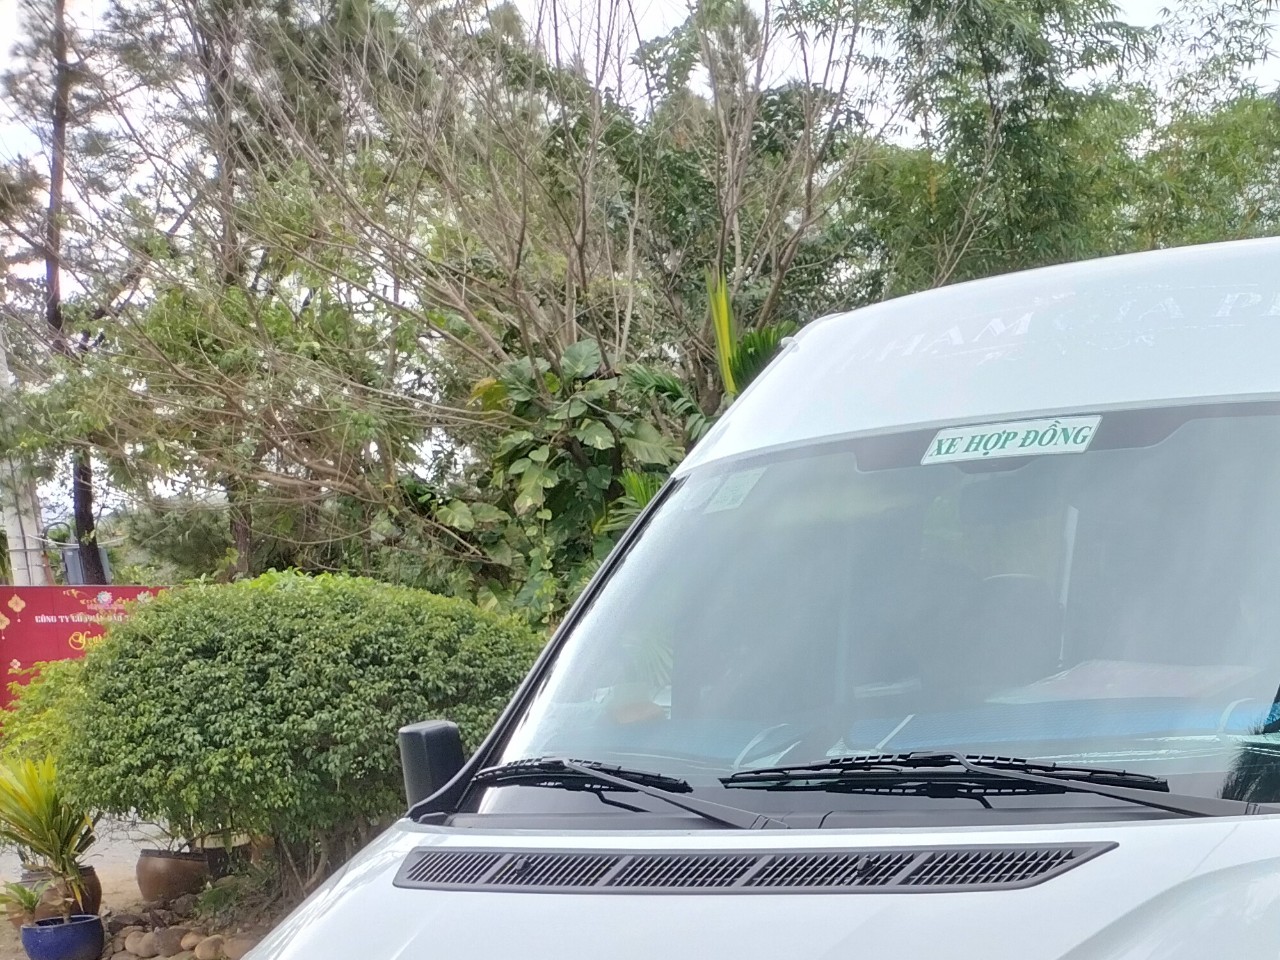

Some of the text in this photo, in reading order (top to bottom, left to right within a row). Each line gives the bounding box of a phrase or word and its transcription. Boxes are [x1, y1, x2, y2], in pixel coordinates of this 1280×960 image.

[1053, 296, 1186, 331] IA
[929, 419, 1093, 457] XE HỢP ĐỒNG
[34, 613, 57, 623] CÔNG
[58, 615, 70, 623] TY
